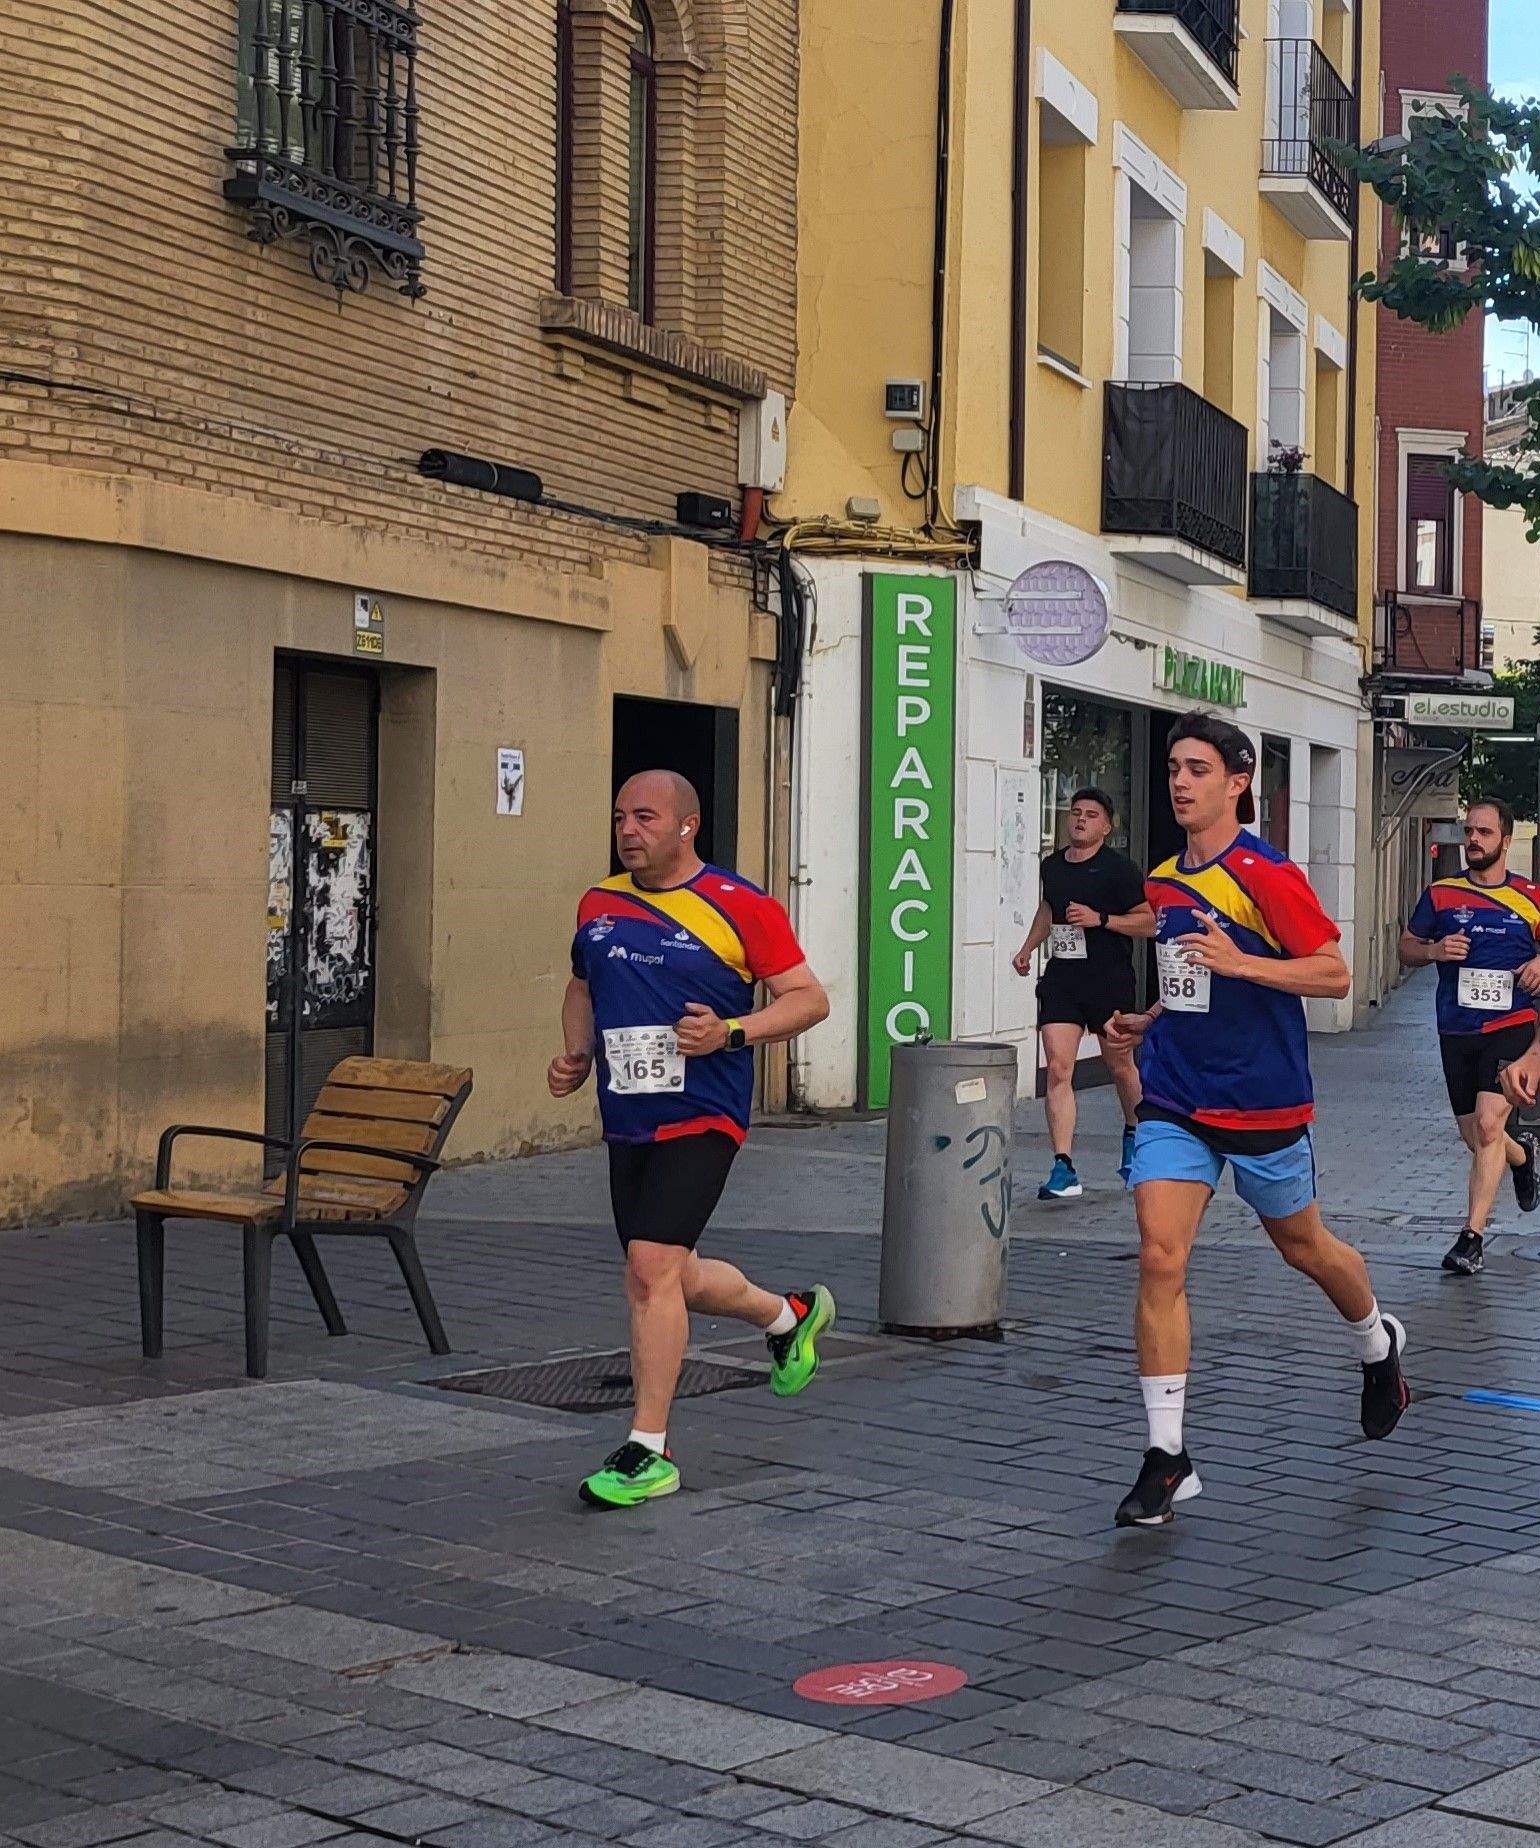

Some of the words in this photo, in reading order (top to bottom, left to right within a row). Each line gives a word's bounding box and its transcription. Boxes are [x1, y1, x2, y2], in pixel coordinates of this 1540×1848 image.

[884, 593, 934, 1042] REPARACIO
[1053, 940, 1077, 952] 293
[1162, 976, 1196, 998] 658
[1470, 988, 1502, 1003] 353
[623, 1058, 666, 1080] 165
